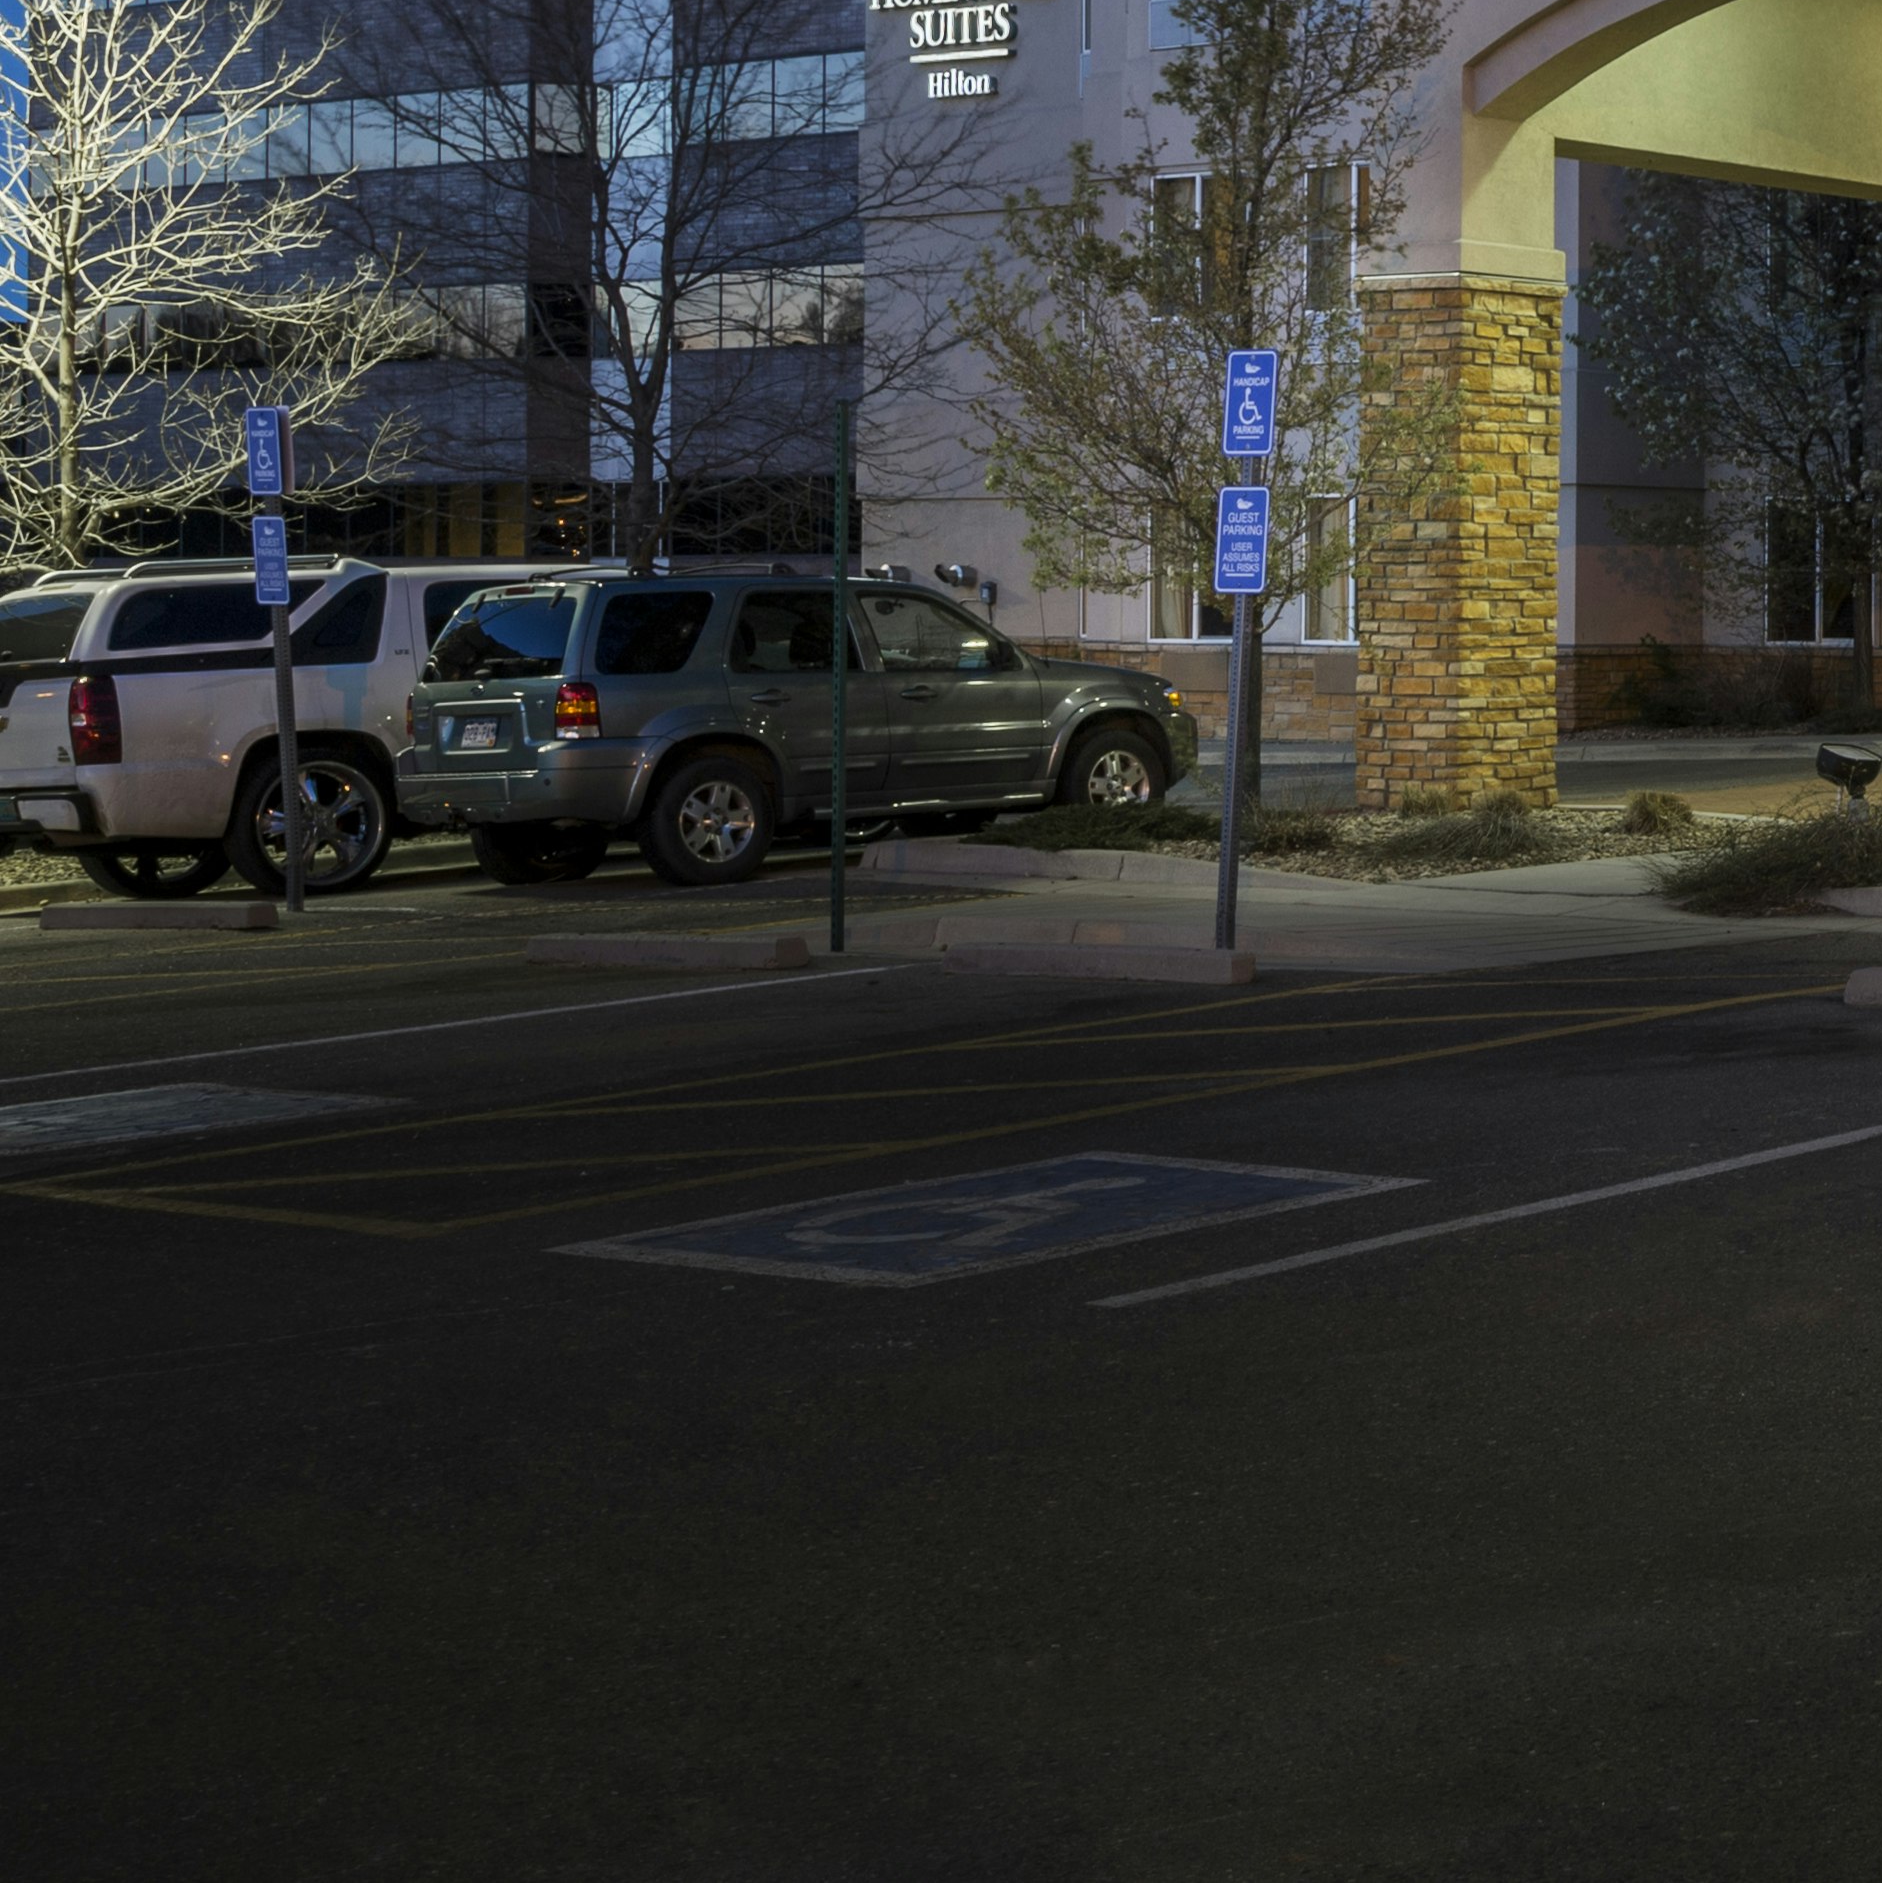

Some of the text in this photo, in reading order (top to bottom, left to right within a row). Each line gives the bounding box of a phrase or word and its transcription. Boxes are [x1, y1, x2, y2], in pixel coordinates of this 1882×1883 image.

[909, 3, 1011, 48] SUITES
[927, 68, 991, 98] Hilton
[1233, 377, 1270, 387] HANDICAP
[1233, 425, 1264, 435] PARKING
[1227, 512, 1260, 524] GUEST
[1222, 524, 1263, 536] PARKING
[1231, 542, 1253, 552] USER
[1222, 552, 1260, 563] ASSUMES
[1221, 562, 1260, 573] ALL RISKS
